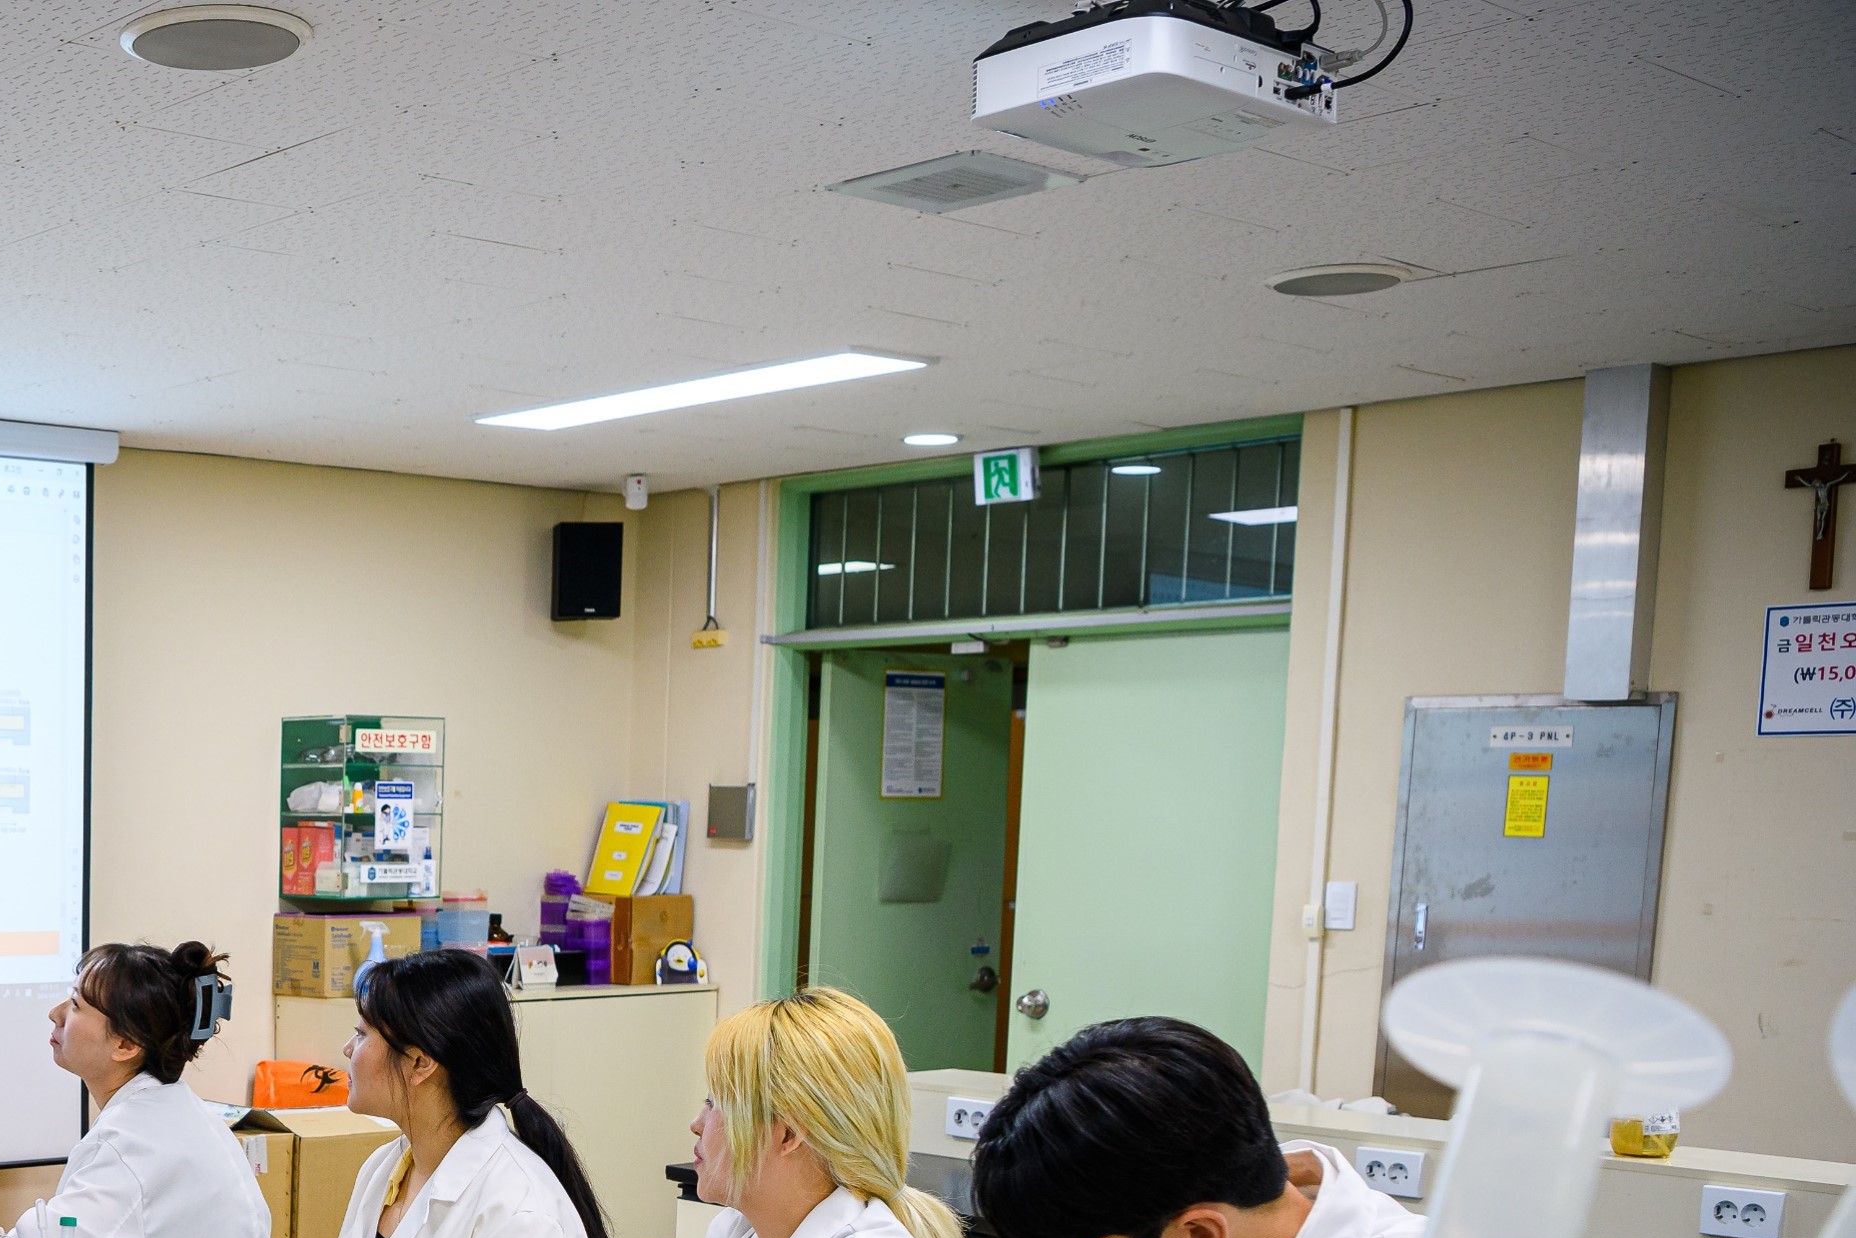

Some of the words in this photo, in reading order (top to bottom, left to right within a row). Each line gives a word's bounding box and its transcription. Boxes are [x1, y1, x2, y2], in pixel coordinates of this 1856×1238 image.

[1777, 638, 1792, 653] 금
[1777, 706, 1824, 715] DREAMCELL
[1830, 697, 1856, 720] (주)
[360, 732, 432, 749] 안전보호구함
[1540, 731, 1559, 741] PNL
